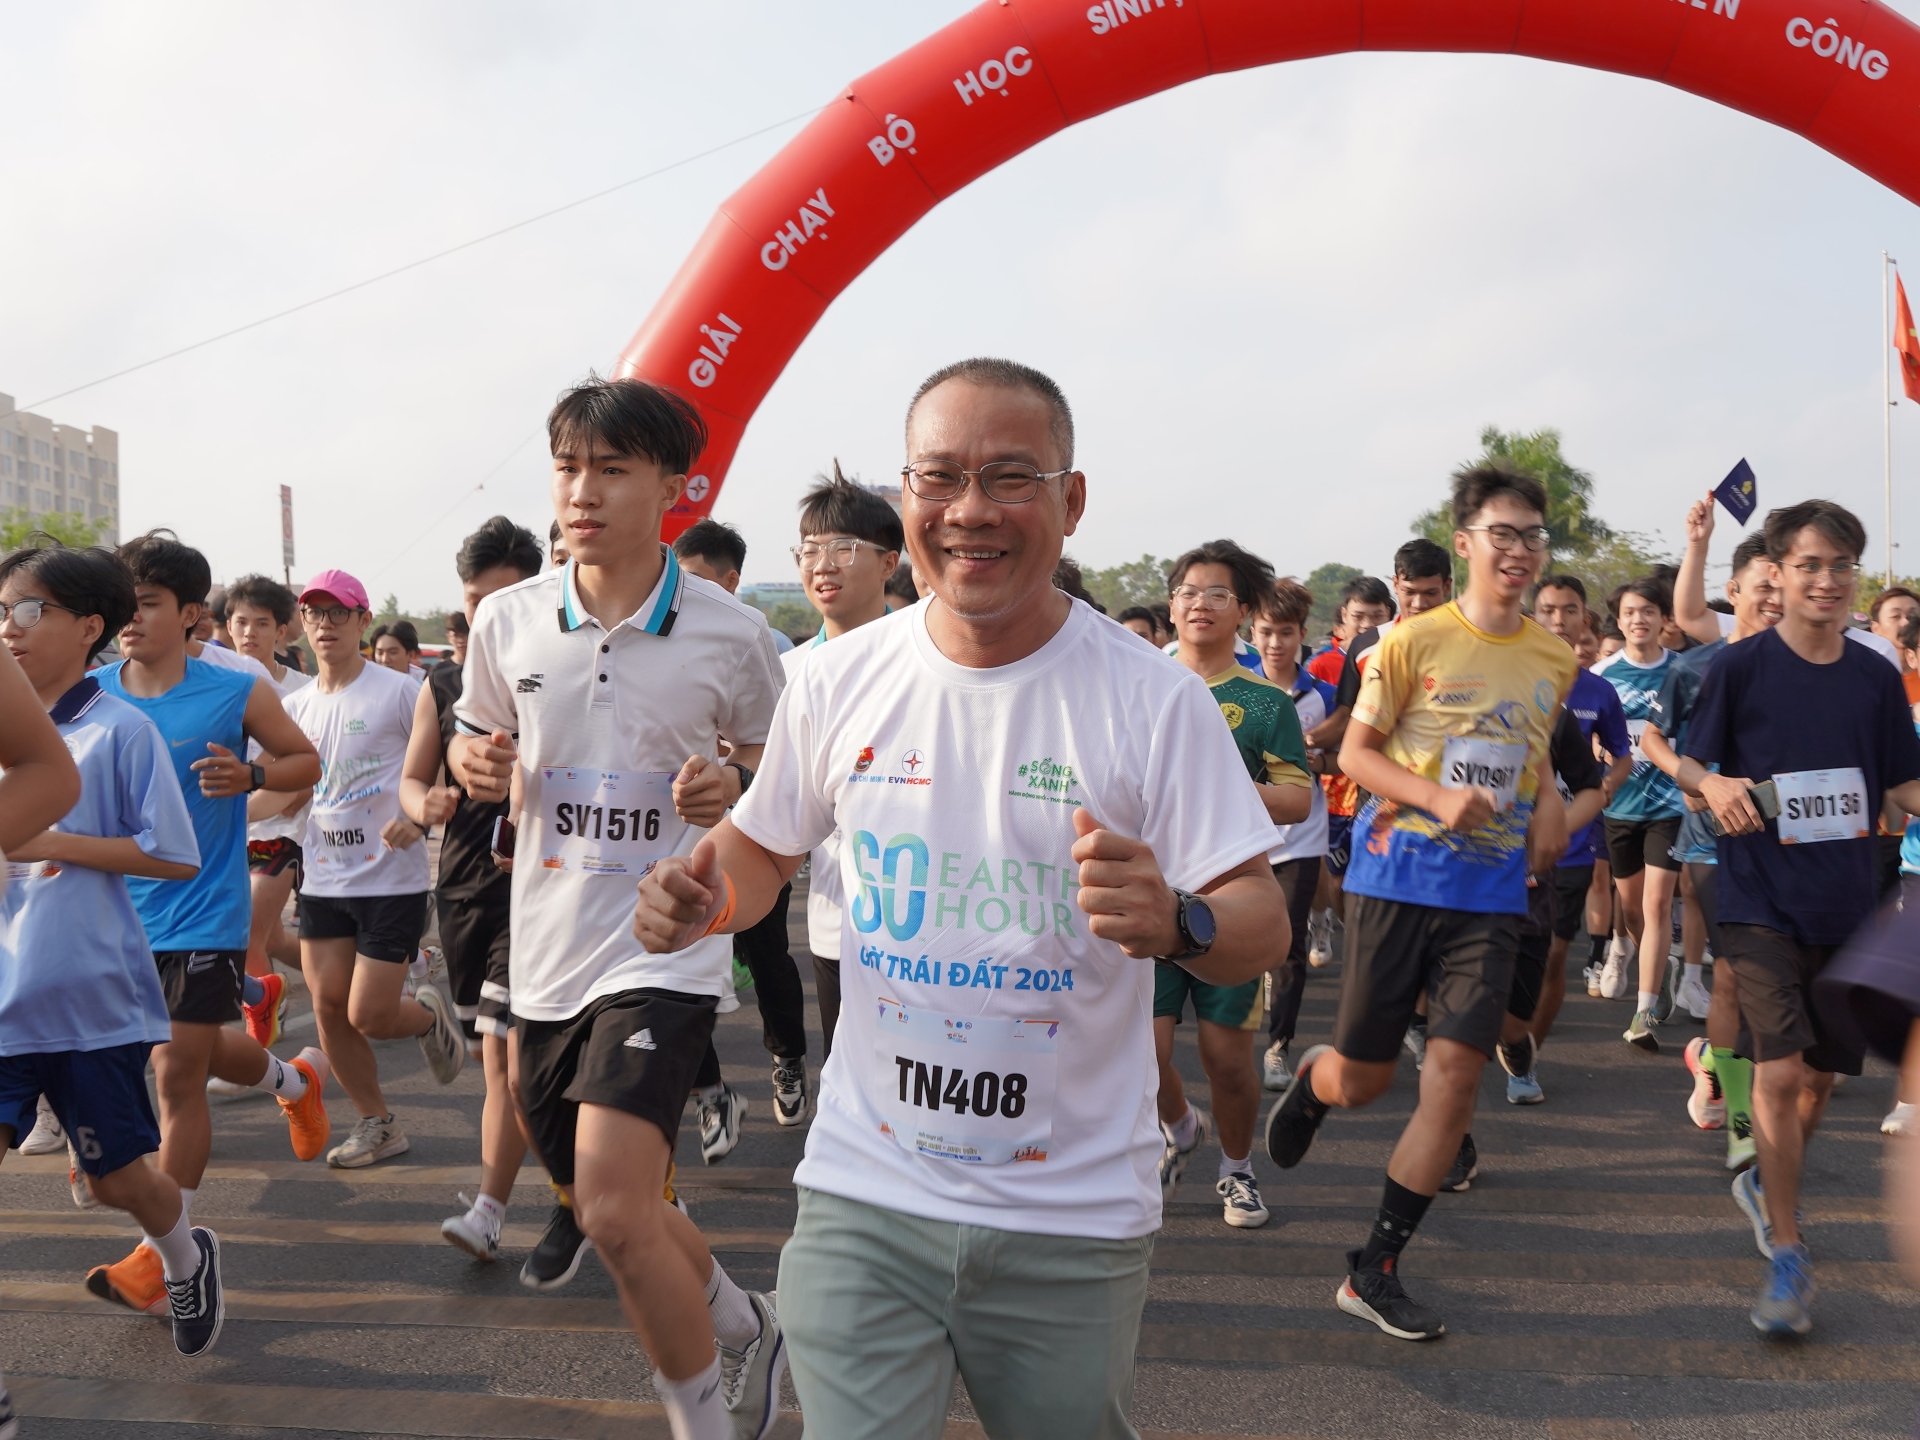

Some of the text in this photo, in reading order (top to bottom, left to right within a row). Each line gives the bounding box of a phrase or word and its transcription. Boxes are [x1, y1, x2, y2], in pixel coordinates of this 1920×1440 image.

[689, 313, 742, 387] GIẢI
[760, 188, 835, 271] CHẠY
[867, 113, 917, 166] BỘ
[953, 46, 1033, 105] HỌC
[1785, 17, 1890, 81] CÔNG
[888, 776, 932, 786] EVNHCMC
[1028, 775, 1070, 793] XANH
[556, 802, 661, 841] SV1516
[1787, 792, 1860, 821] SV0136
[1327, 847, 1349, 869] 10
[851, 829, 930, 942] 60
[935, 892, 1077, 939] HOUR
[886, 954, 942, 986] TRÁI
[948, 957, 1009, 989] ĐẤT
[1015, 968, 1075, 992] 2024
[895, 1055, 1028, 1119] TN408
[76, 1125, 104, 1160] 6
